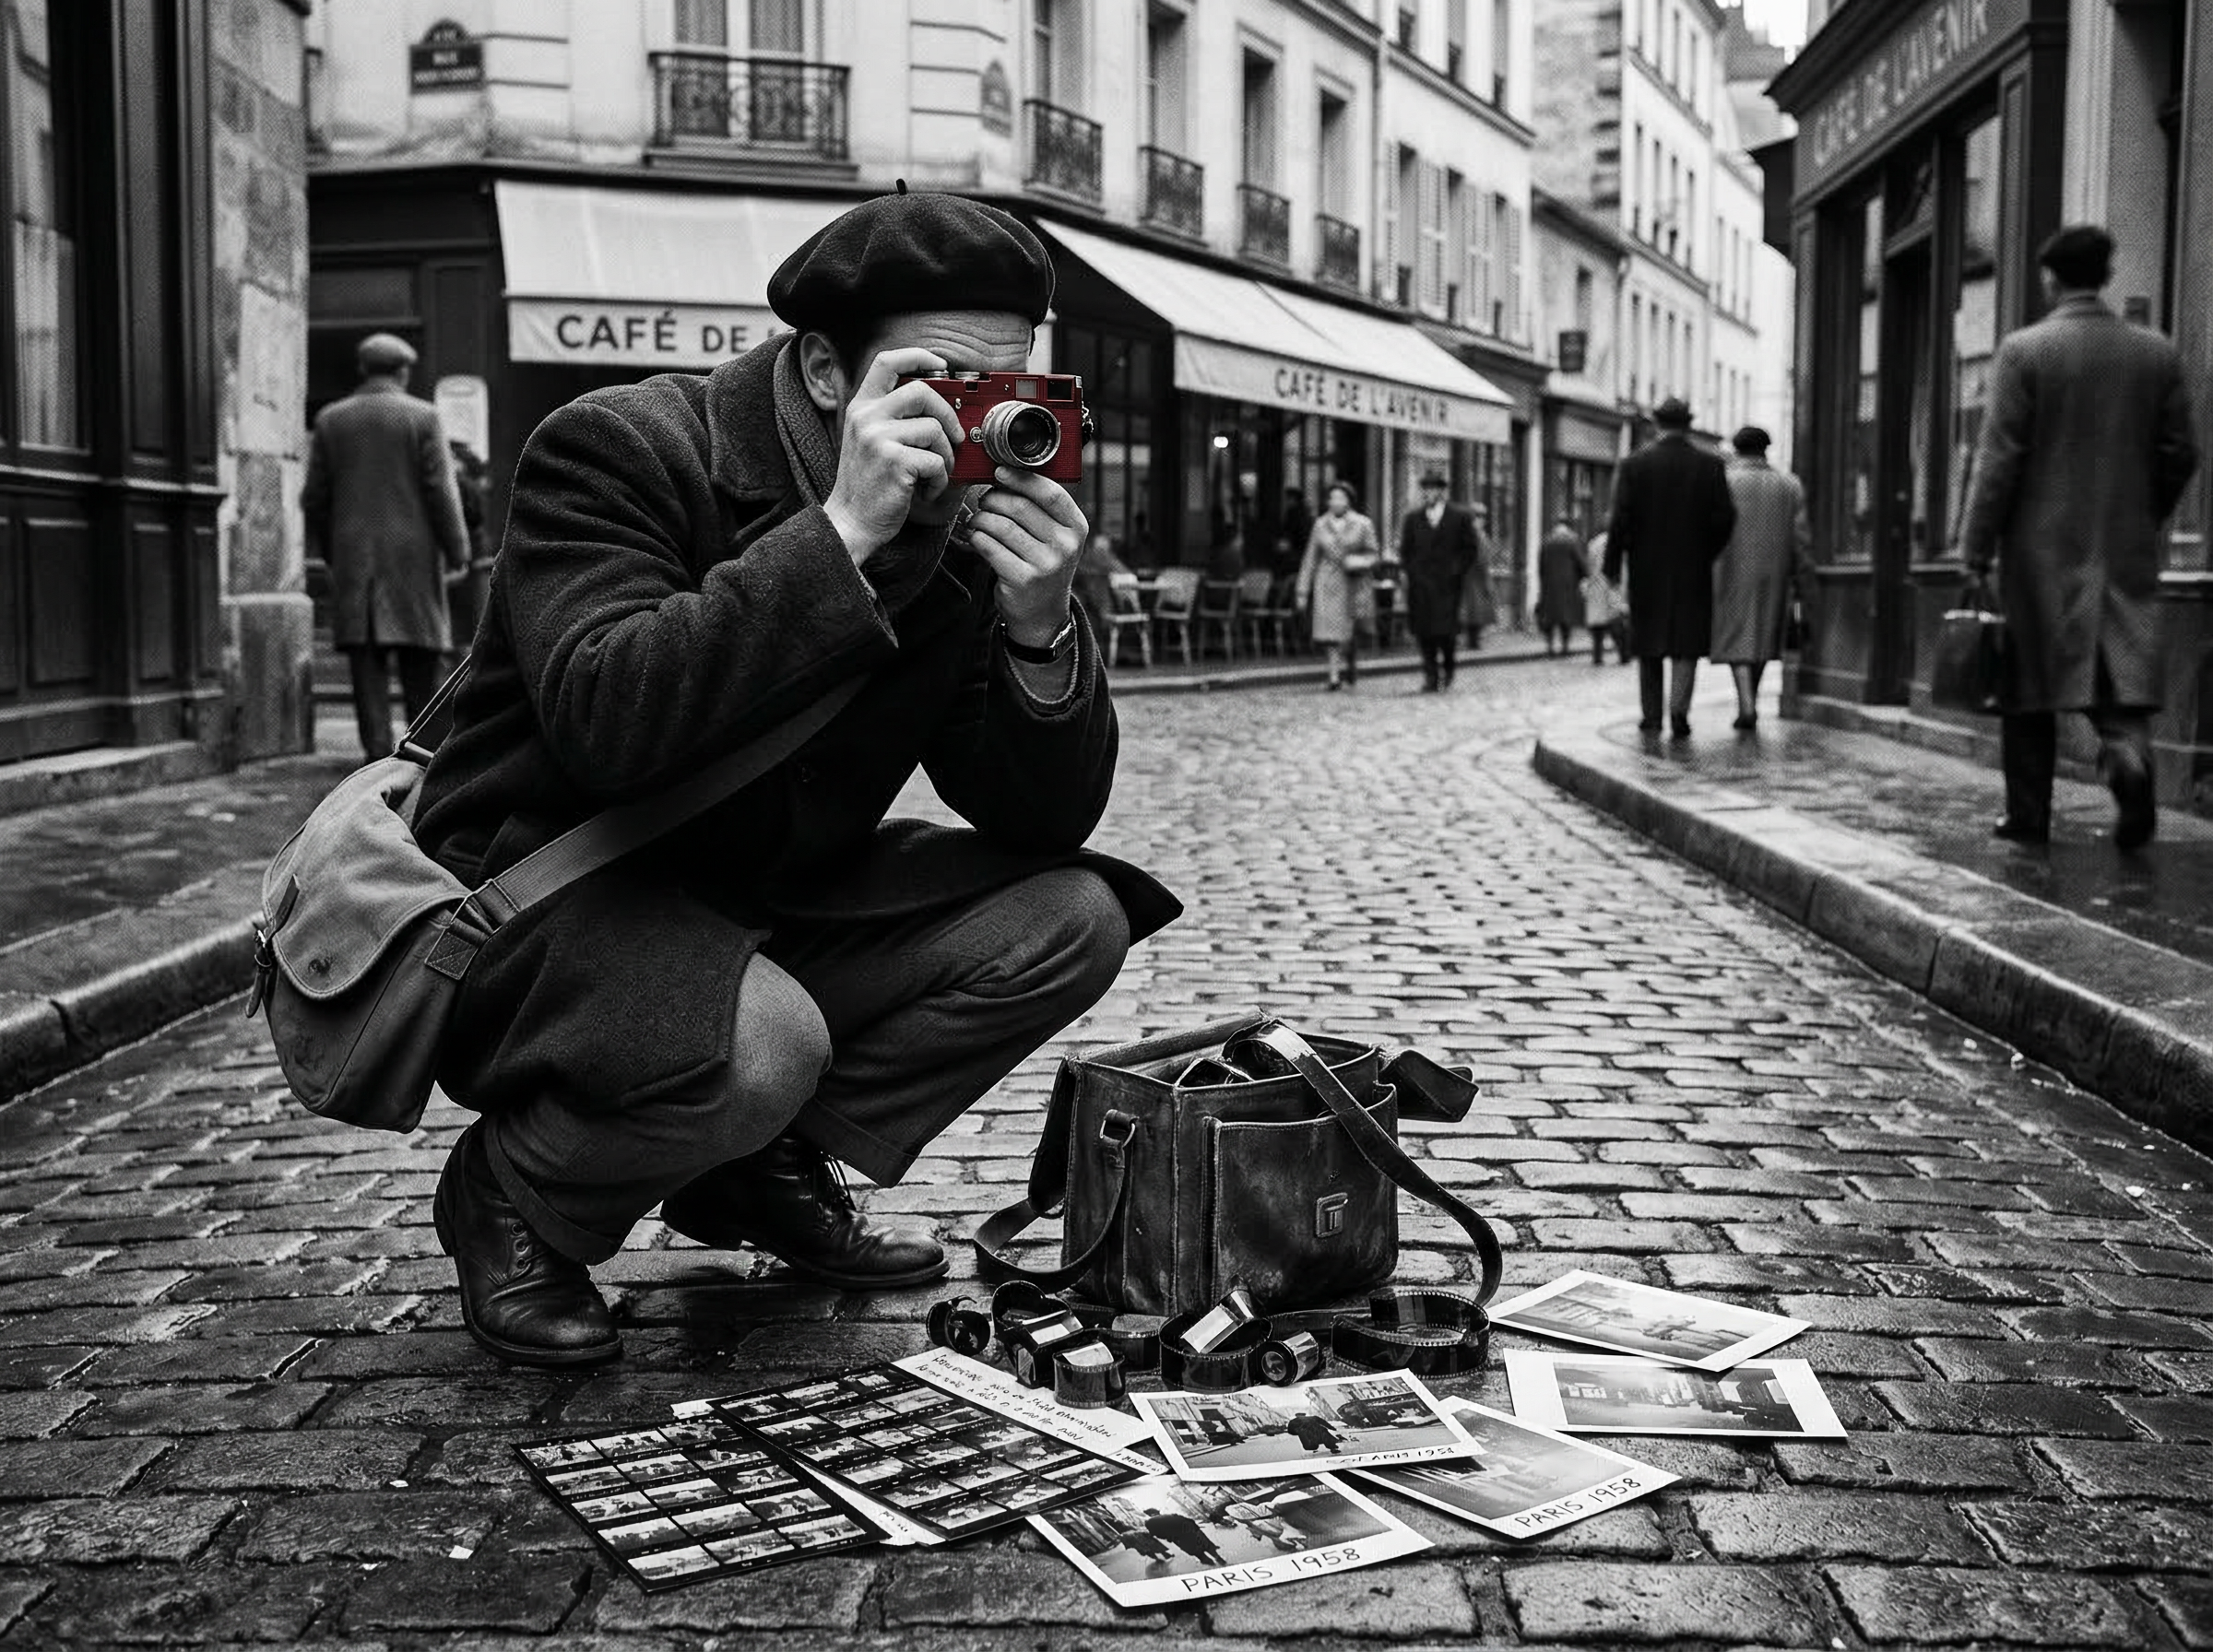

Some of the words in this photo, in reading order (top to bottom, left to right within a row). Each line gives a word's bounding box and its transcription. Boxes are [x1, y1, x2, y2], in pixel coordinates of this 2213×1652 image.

[557, 310, 678, 351] CAFÉ
[702, 325, 749, 353] DE
[1337, 381, 1360, 412] DE
[1515, 1500, 1583, 1527] PARIS
[1588, 1478, 1640, 1503] 1958
[1181, 1566, 1272, 1592] PARIS
[1291, 1548, 1360, 1572] 1958
